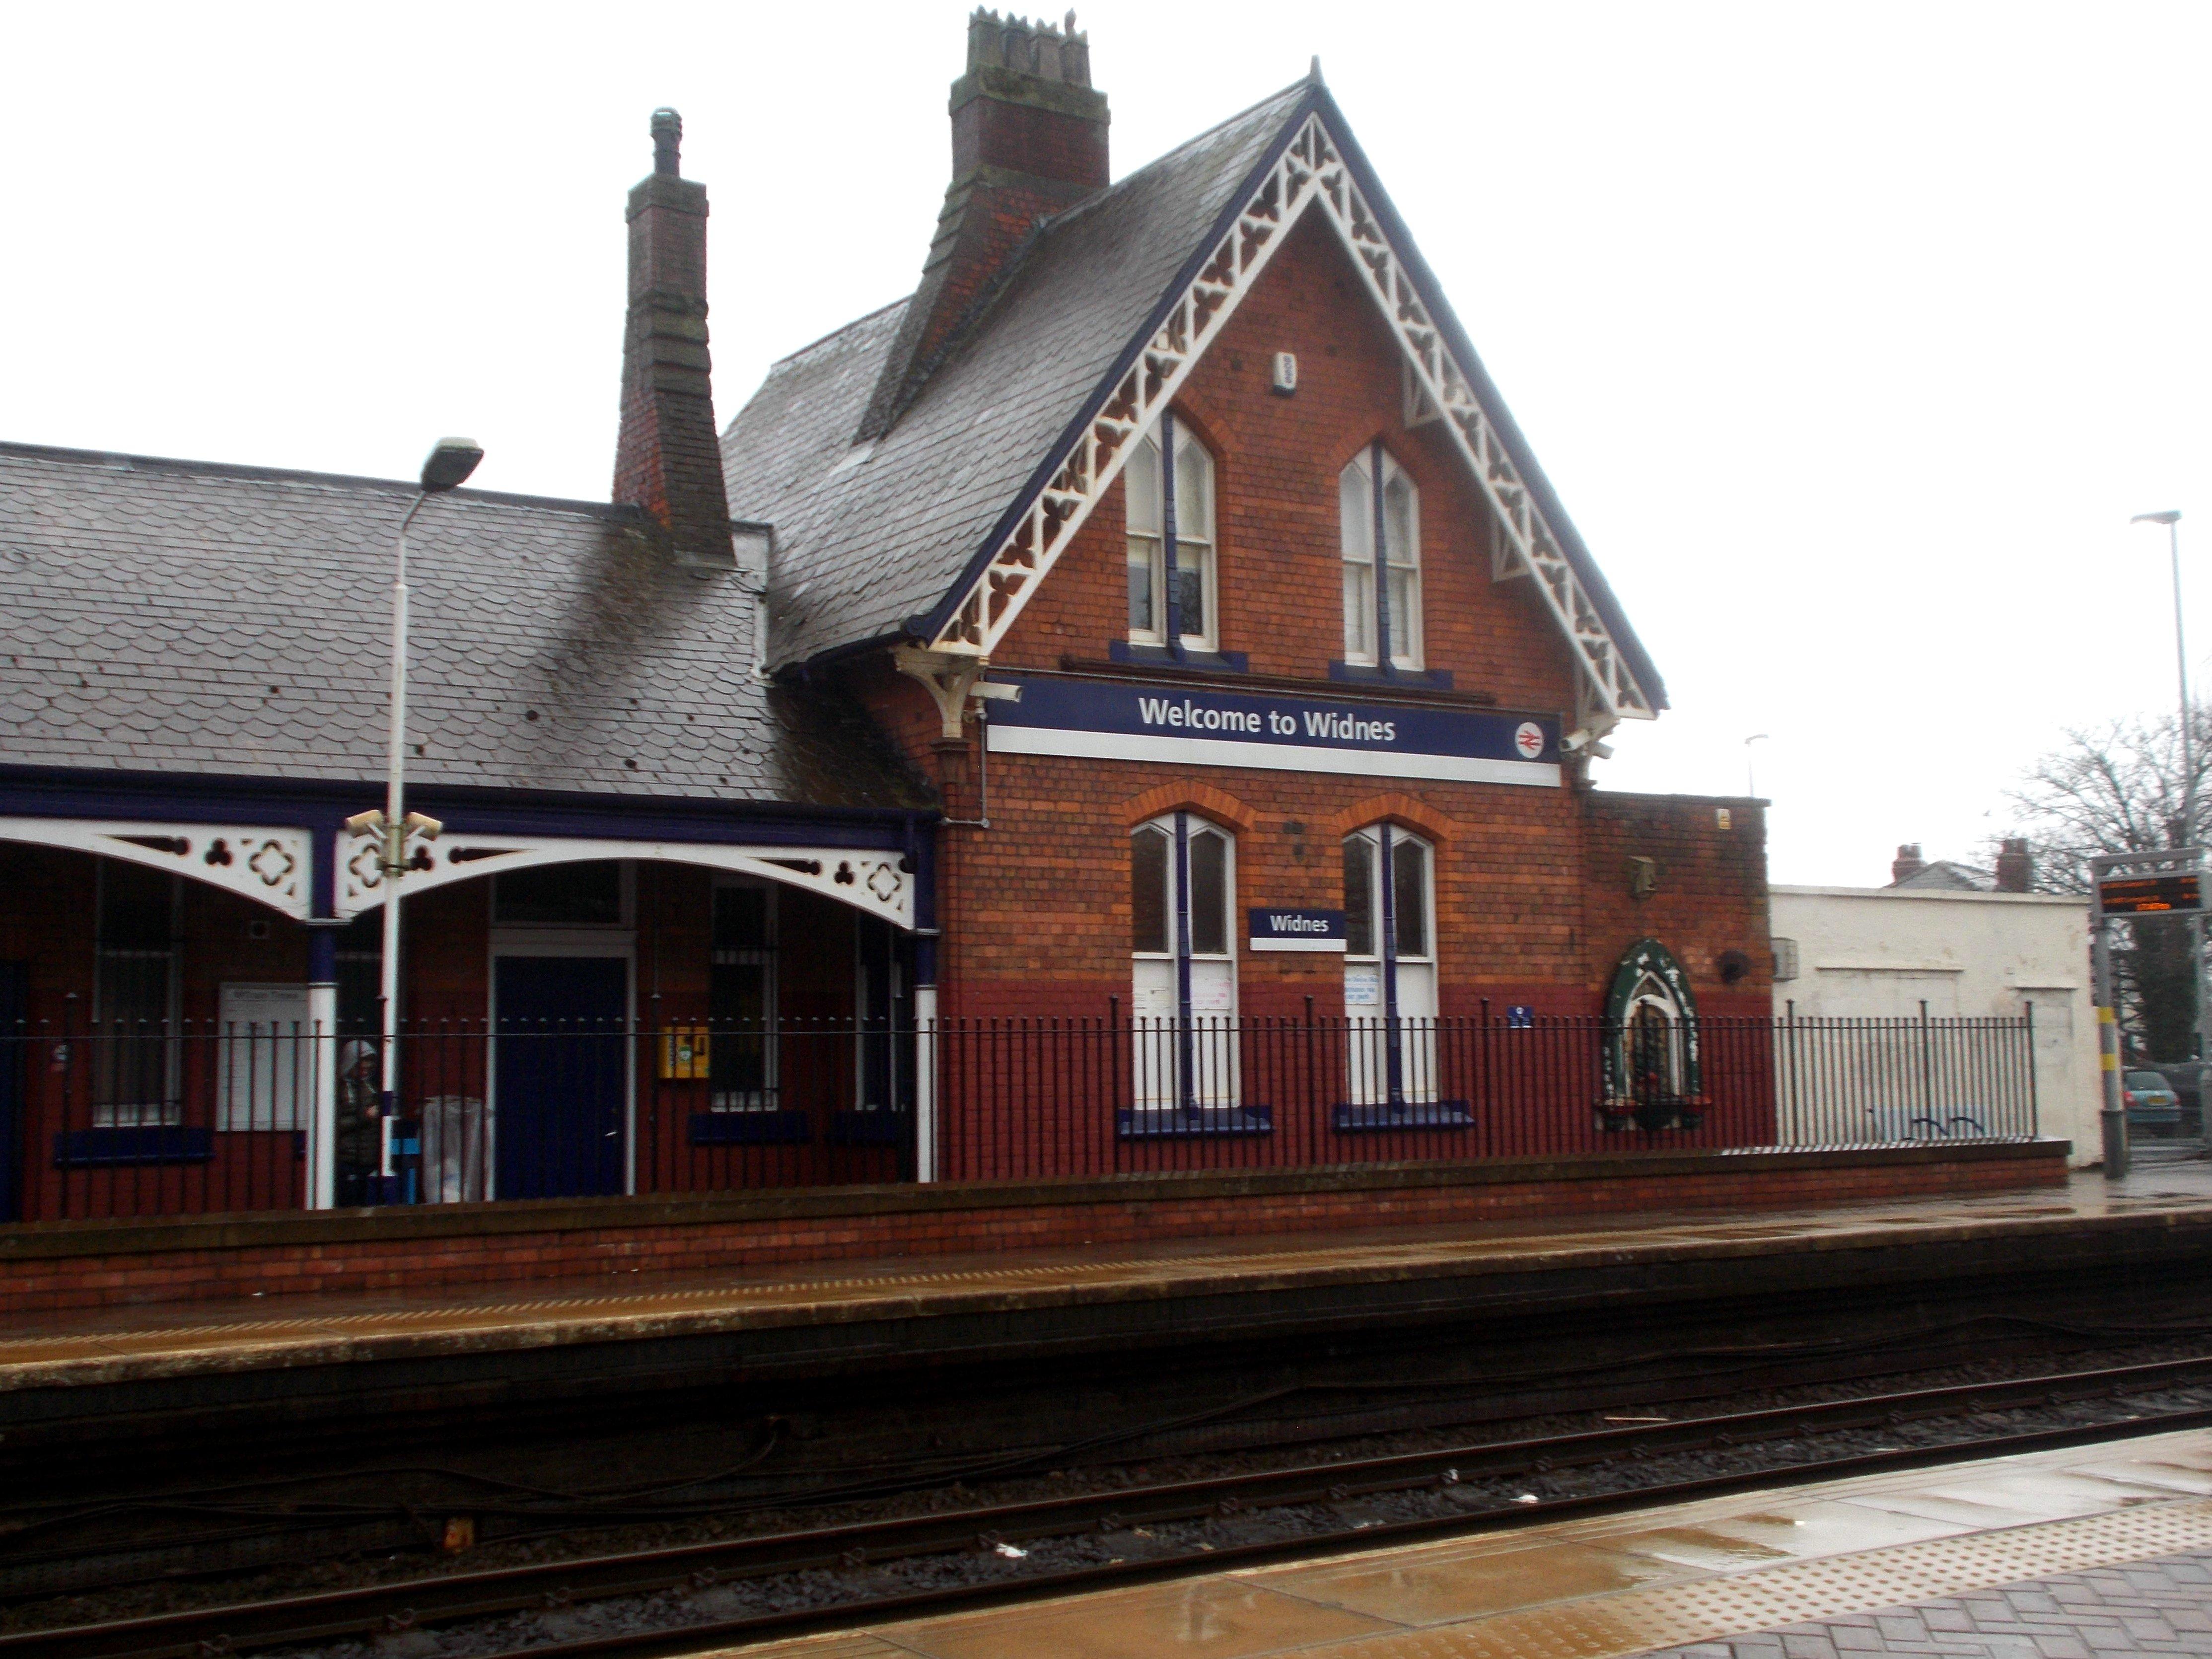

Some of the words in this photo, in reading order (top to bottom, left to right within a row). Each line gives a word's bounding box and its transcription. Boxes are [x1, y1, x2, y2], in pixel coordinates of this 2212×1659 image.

[1139, 698, 1262, 733] Welcome
[1268, 711, 1297, 735] to
[1303, 711, 1397, 741] Widnes
[1270, 915, 1329, 932] Widnes
